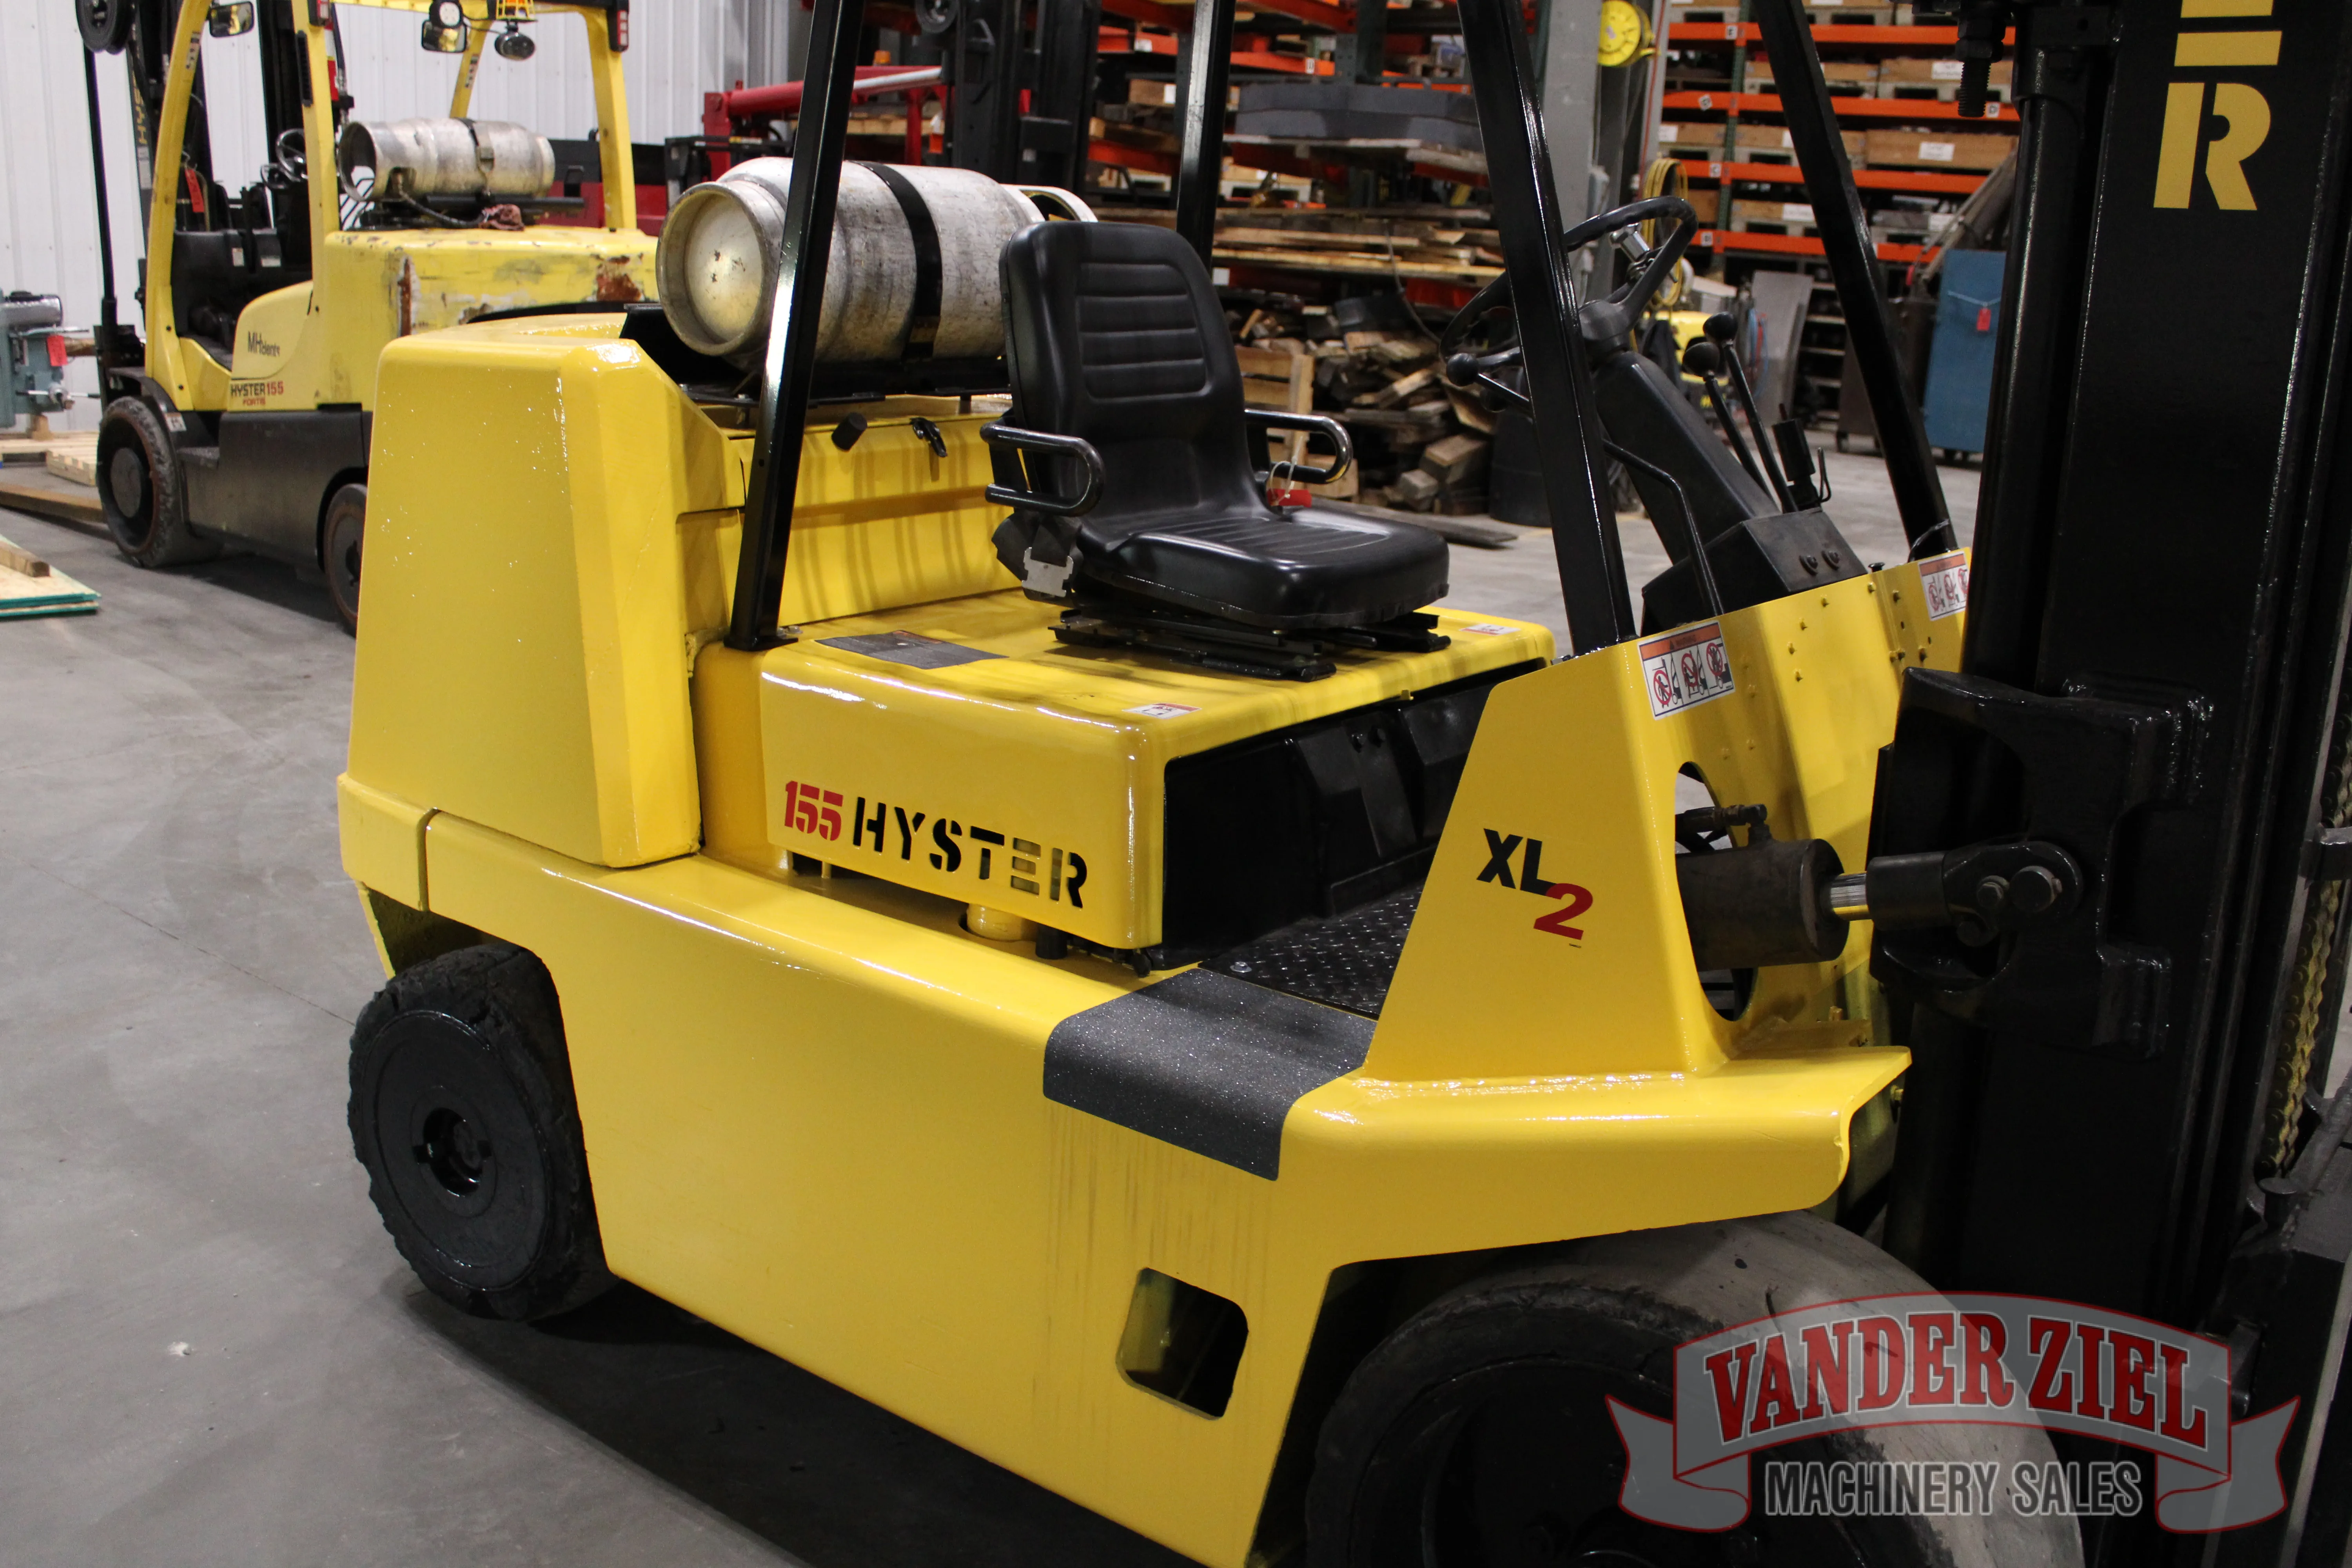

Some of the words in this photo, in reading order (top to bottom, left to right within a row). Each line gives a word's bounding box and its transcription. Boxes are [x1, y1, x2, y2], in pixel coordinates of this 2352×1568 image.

[230, 382, 265, 397] HYSTER
[267, 381, 284, 396] 155
[784, 780, 844, 841] 155
[853, 797, 1087, 908] HYSTER
